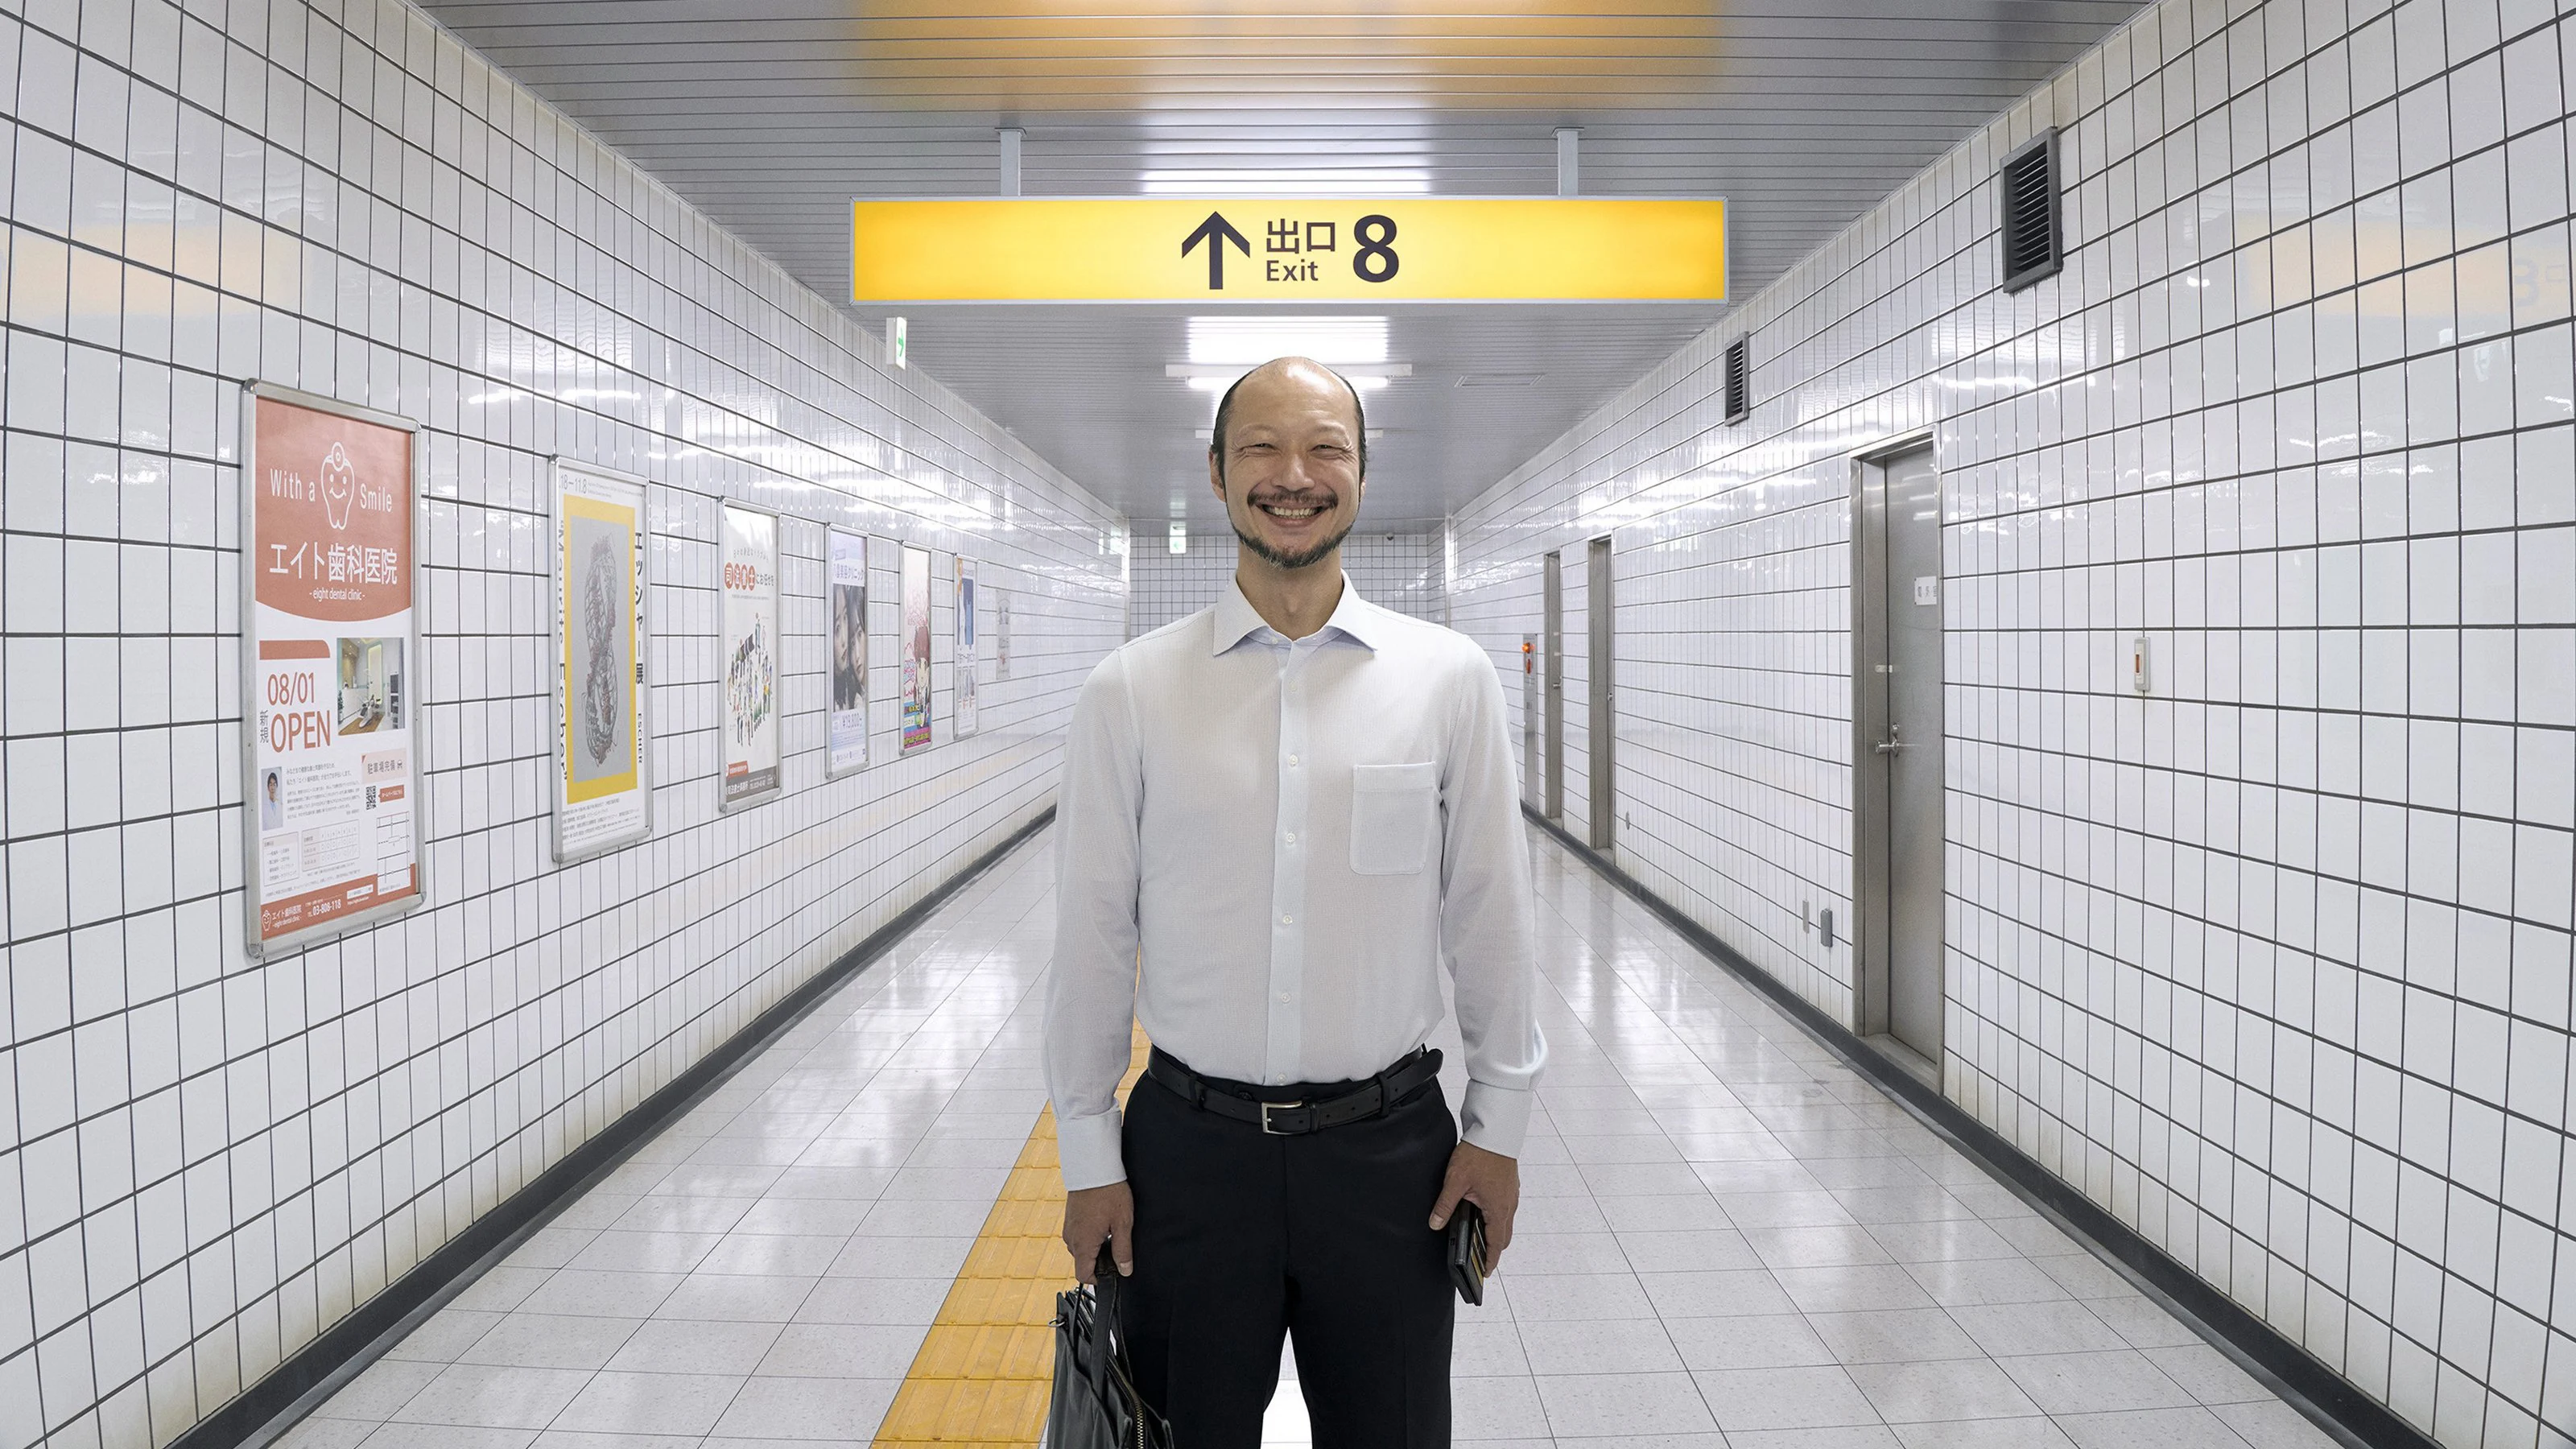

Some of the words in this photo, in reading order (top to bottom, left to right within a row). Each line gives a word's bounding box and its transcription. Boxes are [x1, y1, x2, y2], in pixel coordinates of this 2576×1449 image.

[1265, 218, 1336, 254] 出口
[1352, 214, 1400, 283] 8
[1266, 258, 1319, 283] Exit
[270, 469, 303, 500] With
[308, 482, 316, 502] a
[360, 485, 393, 513] Smile
[269, 541, 398, 585] エイト歯科医院
[328, 588, 348, 601] dental
[634, 532, 643, 685] エッシャー展
[267, 671, 315, 706] 08/01
[270, 710, 331, 753] OPEN
